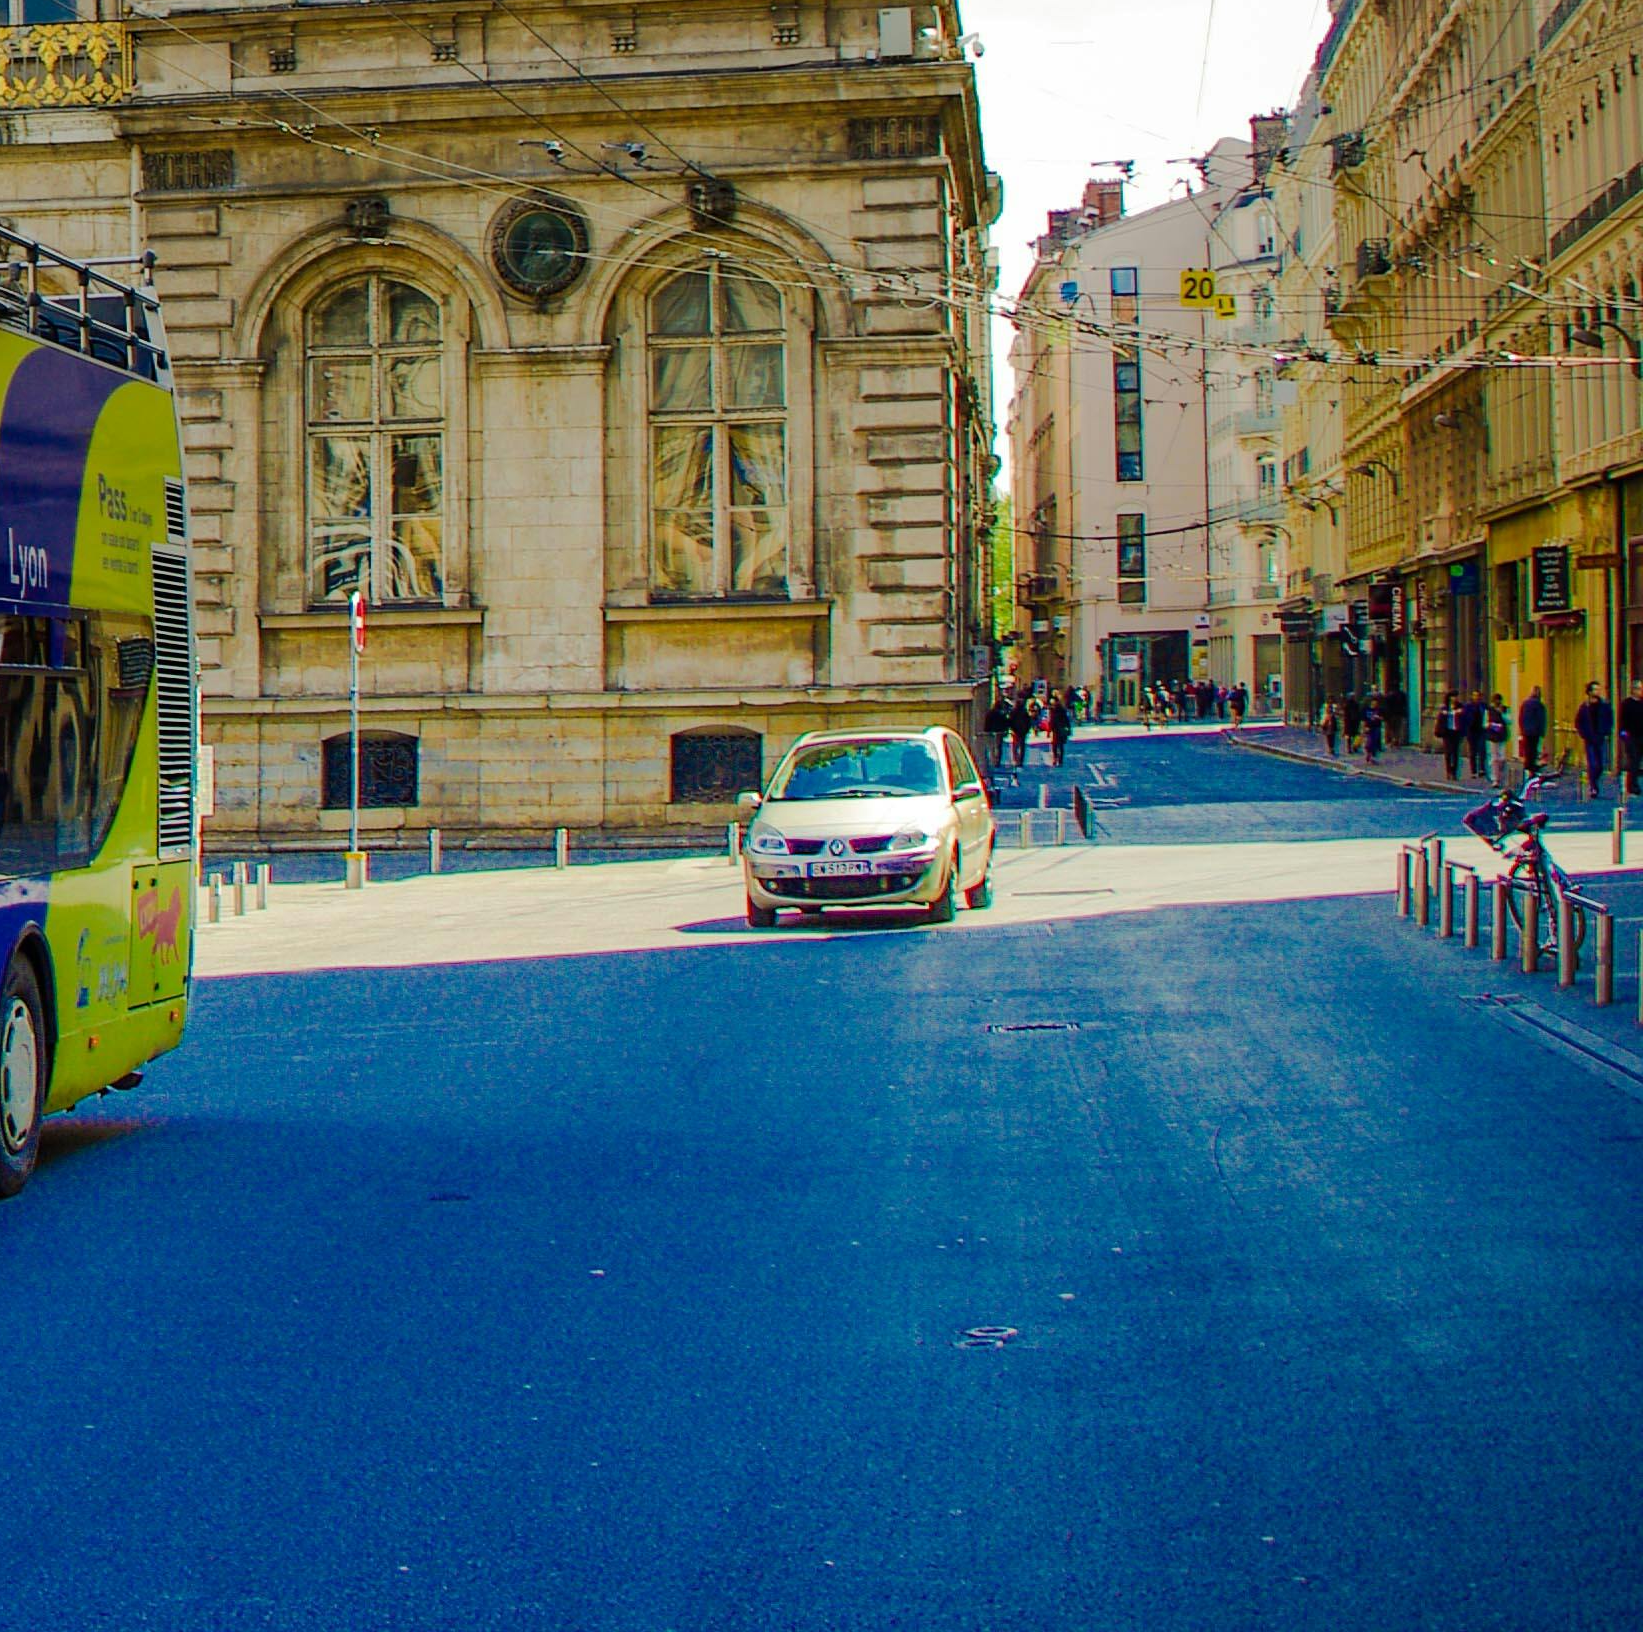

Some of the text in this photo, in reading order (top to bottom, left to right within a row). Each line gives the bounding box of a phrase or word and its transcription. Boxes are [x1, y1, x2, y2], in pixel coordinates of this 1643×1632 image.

[1183, 277, 1213, 299] 20
[98, 472, 128, 522] Pass
[8, 527, 48, 601] Lyon
[1391, 587, 1402, 632] CINEMA
